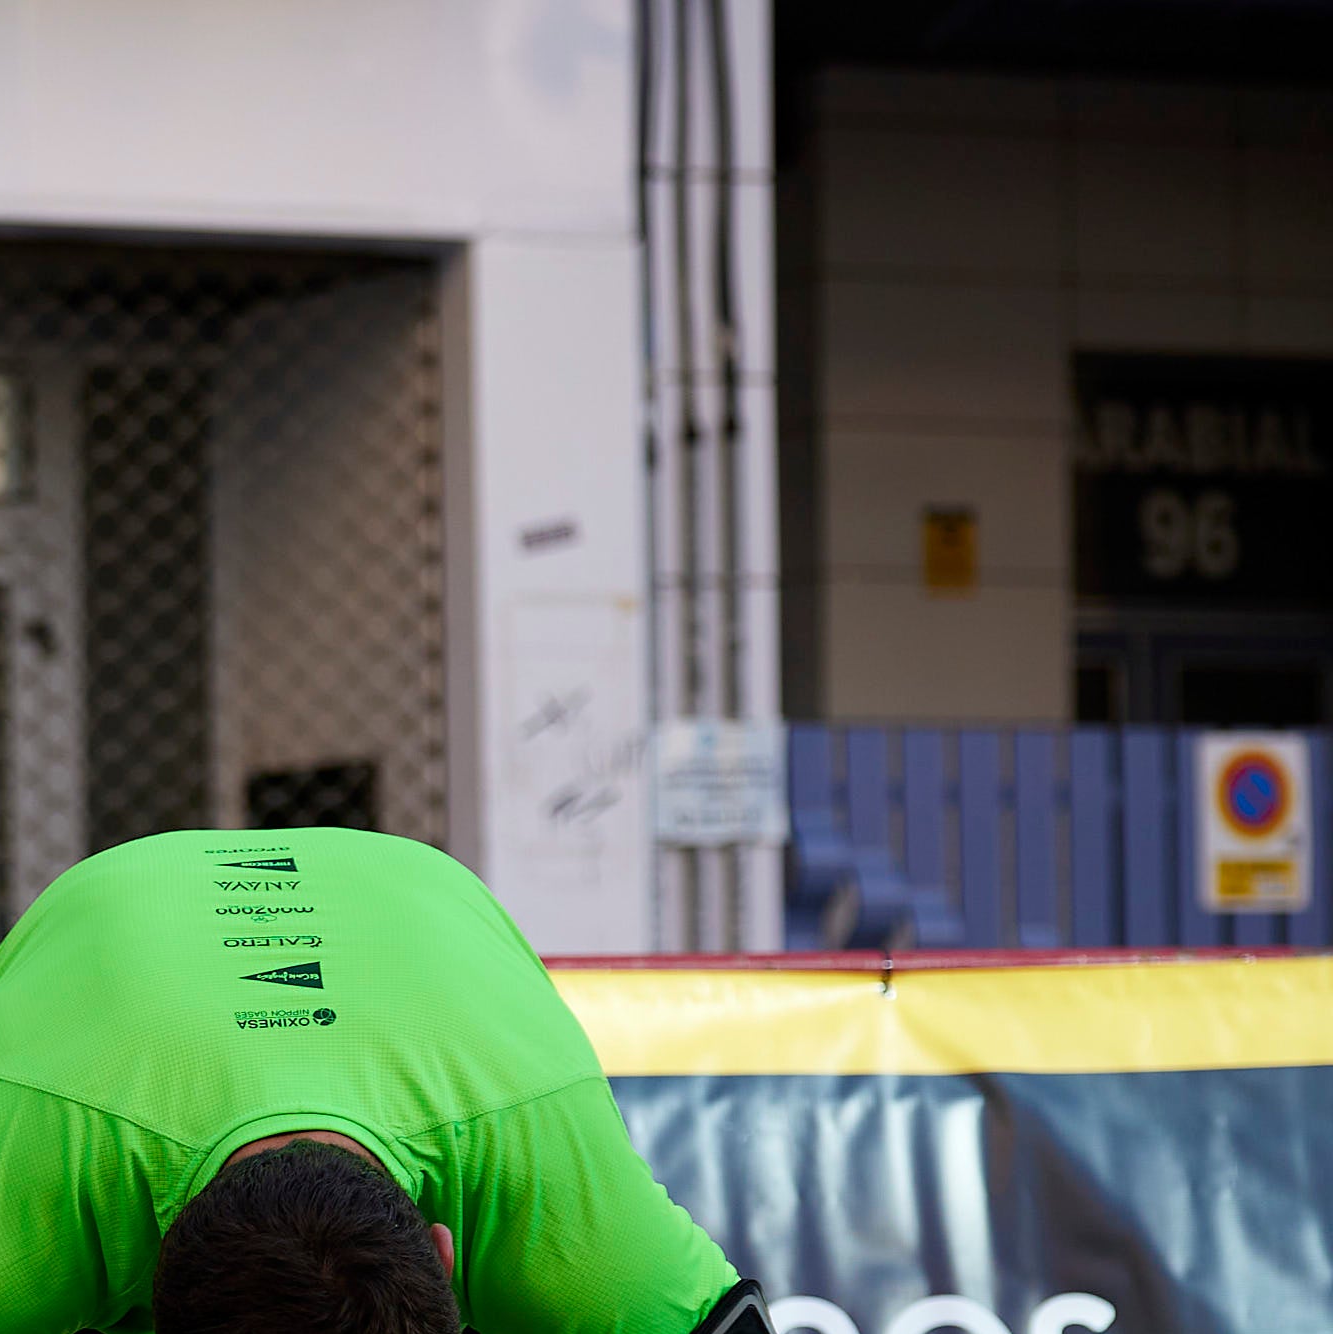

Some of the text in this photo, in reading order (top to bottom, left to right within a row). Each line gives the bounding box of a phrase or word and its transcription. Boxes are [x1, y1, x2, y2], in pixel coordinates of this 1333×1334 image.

[1136, 482, 1242, 578] 96
[213, 880, 302, 891] ANAYA
[223, 936, 322, 948] CALERO
[234, 1008, 310, 1019] NIPPON GASES
[236, 1017, 310, 1030] OXIMESA
